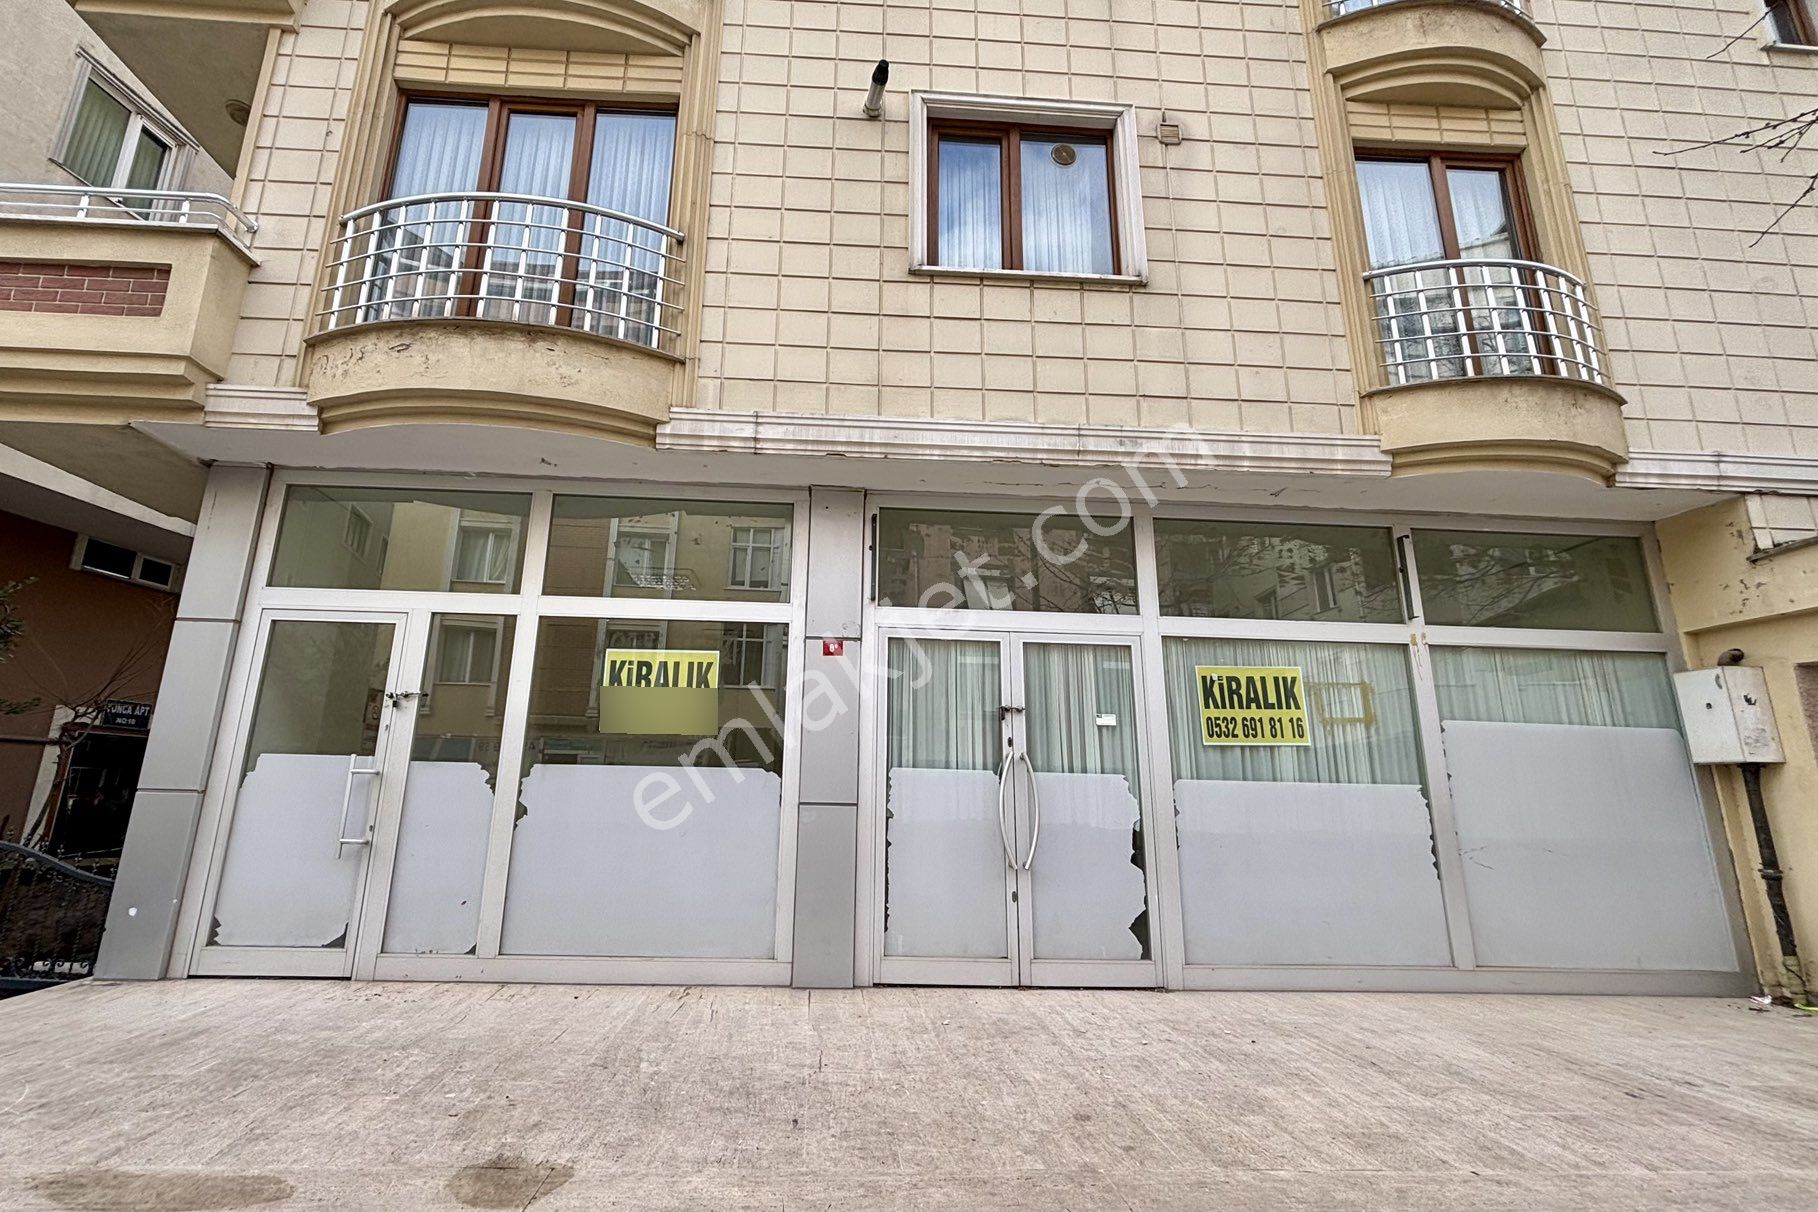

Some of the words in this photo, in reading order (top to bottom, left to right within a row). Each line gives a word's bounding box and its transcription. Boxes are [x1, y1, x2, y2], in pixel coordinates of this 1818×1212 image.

[1206, 716, 1239, 739] 0532
[1241, 717, 1265, 739] 691
[1269, 717, 1285, 739] 81
[1289, 717, 1305, 739] 16
